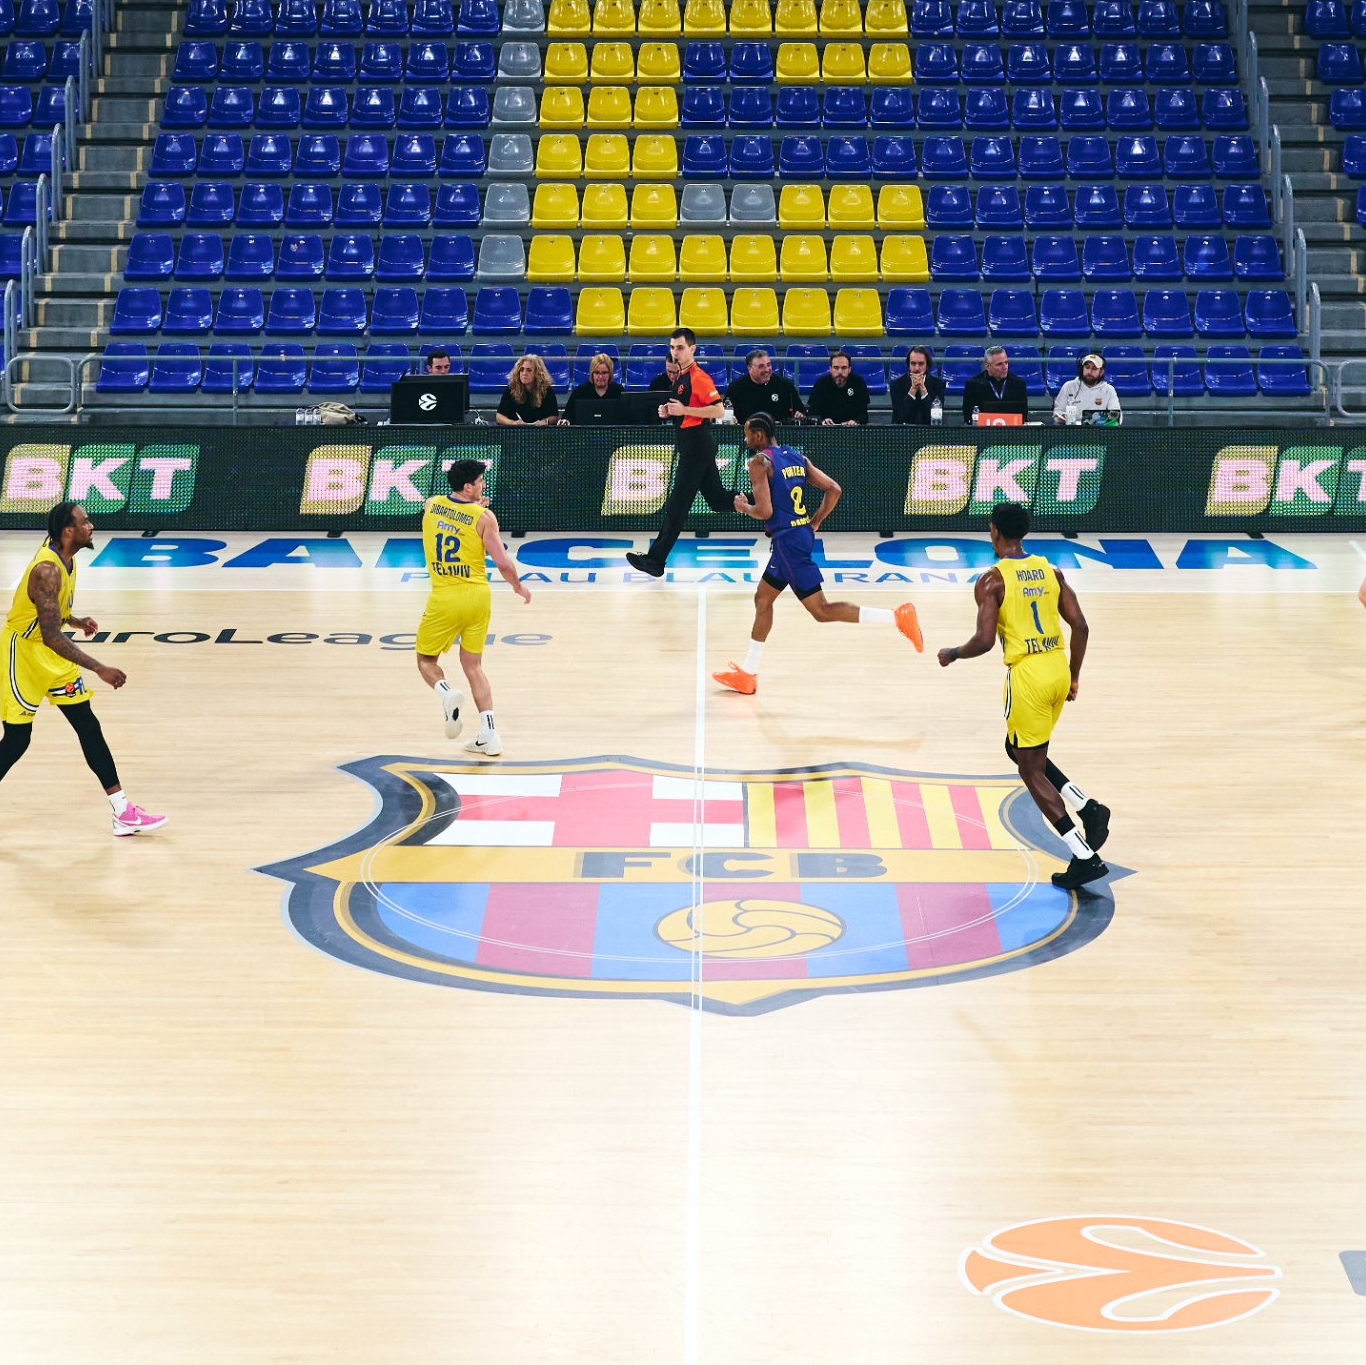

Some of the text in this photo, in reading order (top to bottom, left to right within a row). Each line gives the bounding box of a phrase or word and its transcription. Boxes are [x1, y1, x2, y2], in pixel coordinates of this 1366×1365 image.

[5, 458, 193, 501] BKT
[907, 458, 1097, 502] BKT
[435, 533, 460, 562] 12
[1016, 569, 1045, 581] HOARD
[1031, 601, 1044, 634] 1
